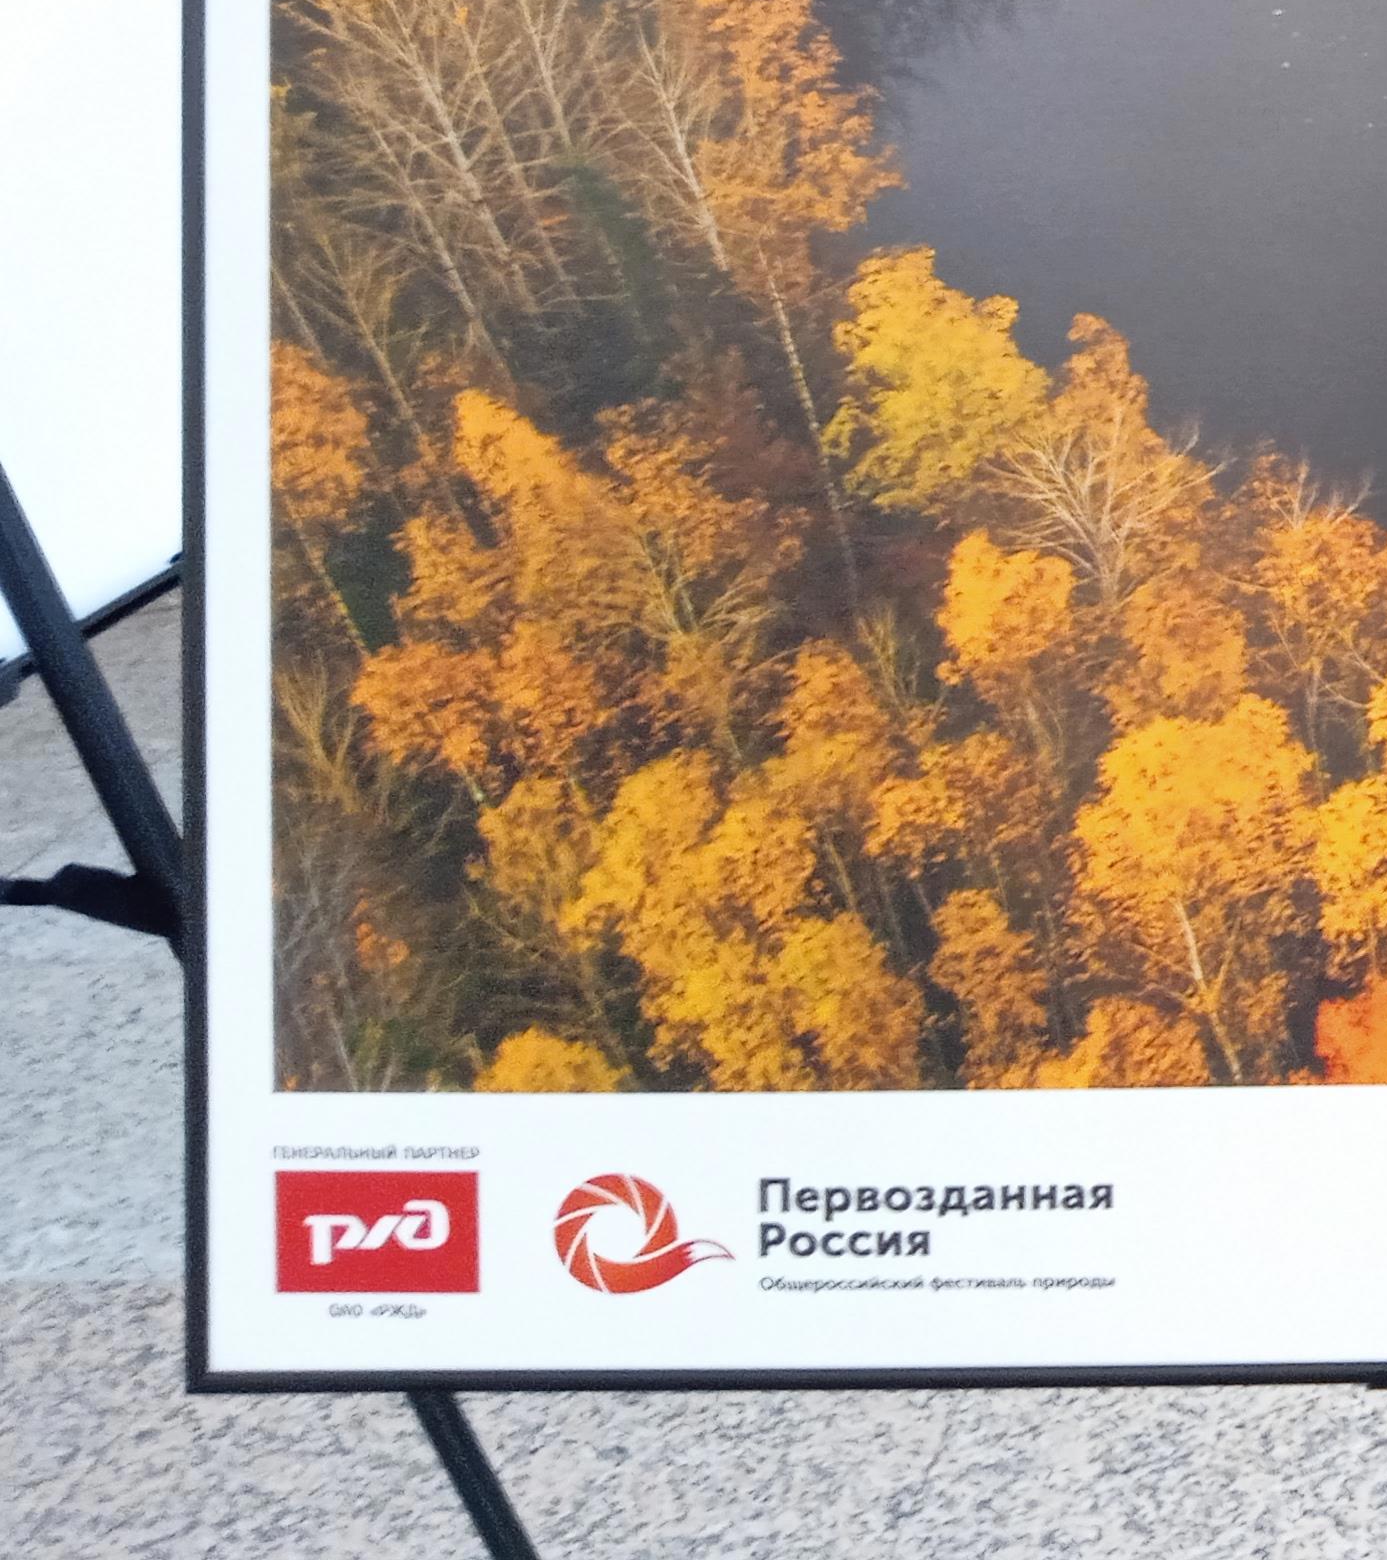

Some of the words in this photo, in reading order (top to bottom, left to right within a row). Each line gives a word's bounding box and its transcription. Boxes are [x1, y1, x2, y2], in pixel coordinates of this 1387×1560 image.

[273, 1145, 397, 1160] ГЕНЕРАЛЬНЫЙ
[404, 1146, 480, 1160] ПАРТНЕР
[758, 1177, 1114, 1216] Первозданная
[758, 1222, 931, 1258] Россия
[758, 1275, 924, 1293] Общероссийский
[930, 1276, 1026, 1293] фестиваль
[1032, 1276, 1116, 1293] природы
[329, 1303, 364, 1318] ОАО
[370, 1303, 427, 1319] «РЖД»
